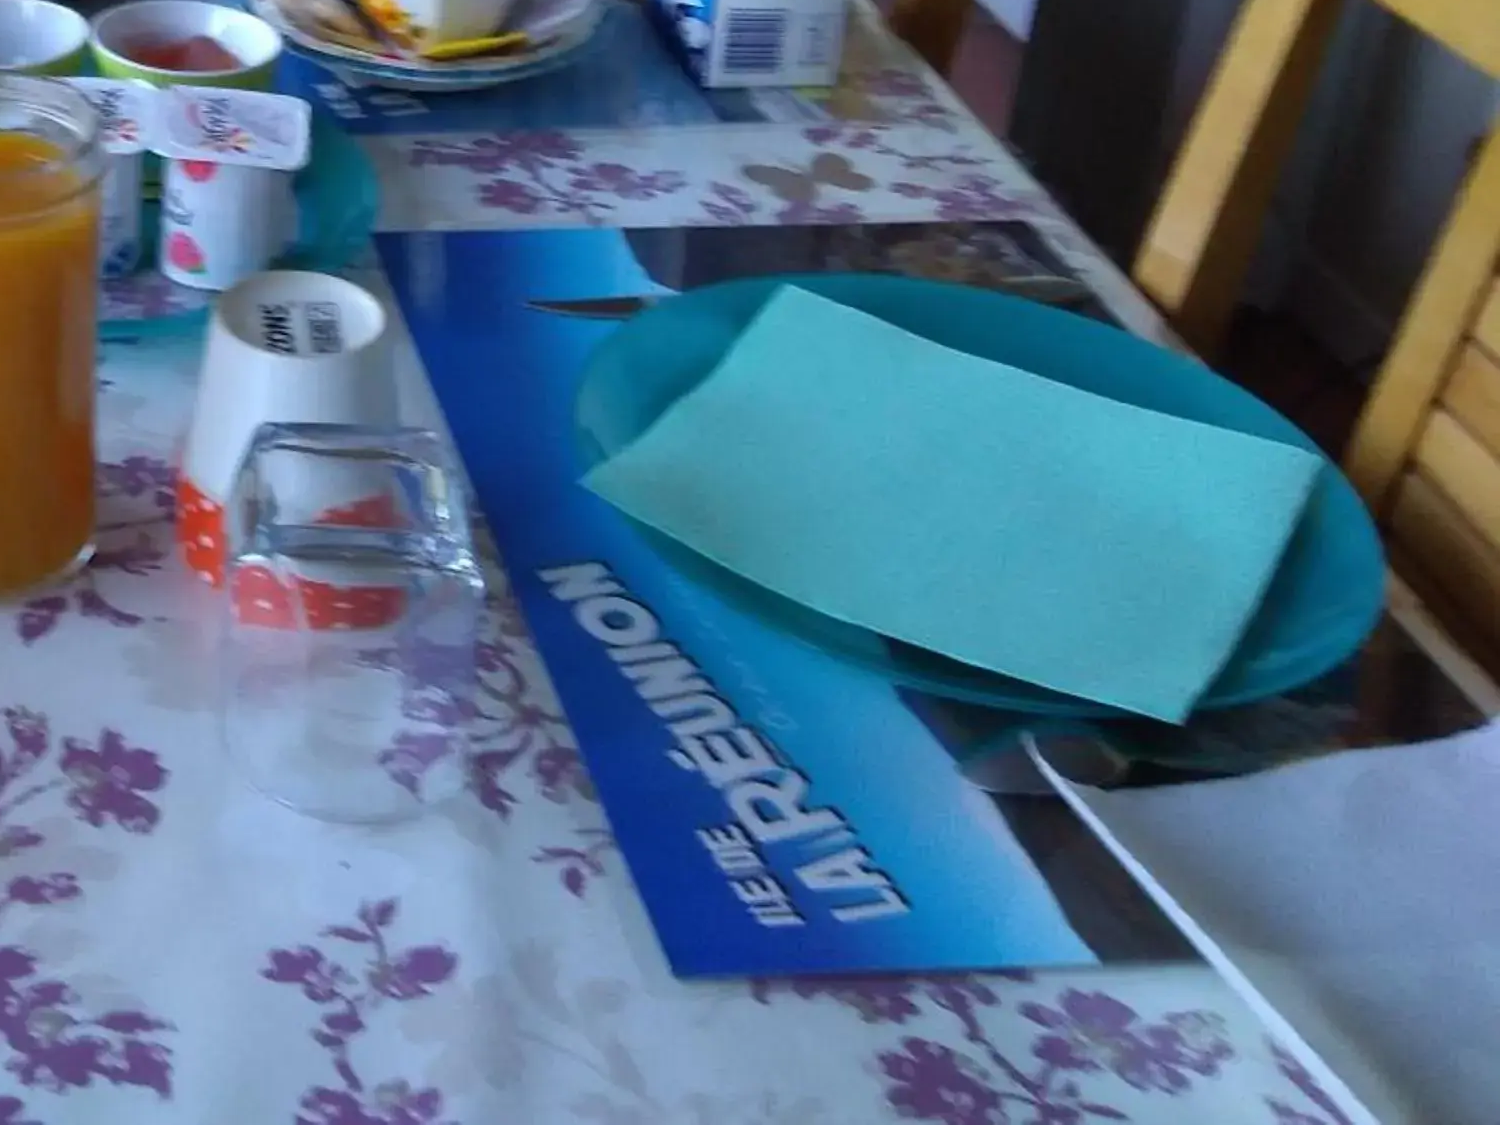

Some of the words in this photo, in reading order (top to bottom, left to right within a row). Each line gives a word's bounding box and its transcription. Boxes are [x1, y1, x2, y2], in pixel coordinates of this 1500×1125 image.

[536, 560, 849, 845] RÉUNION
[694, 823, 767, 876] DE
[793, 847, 913, 924] LA
